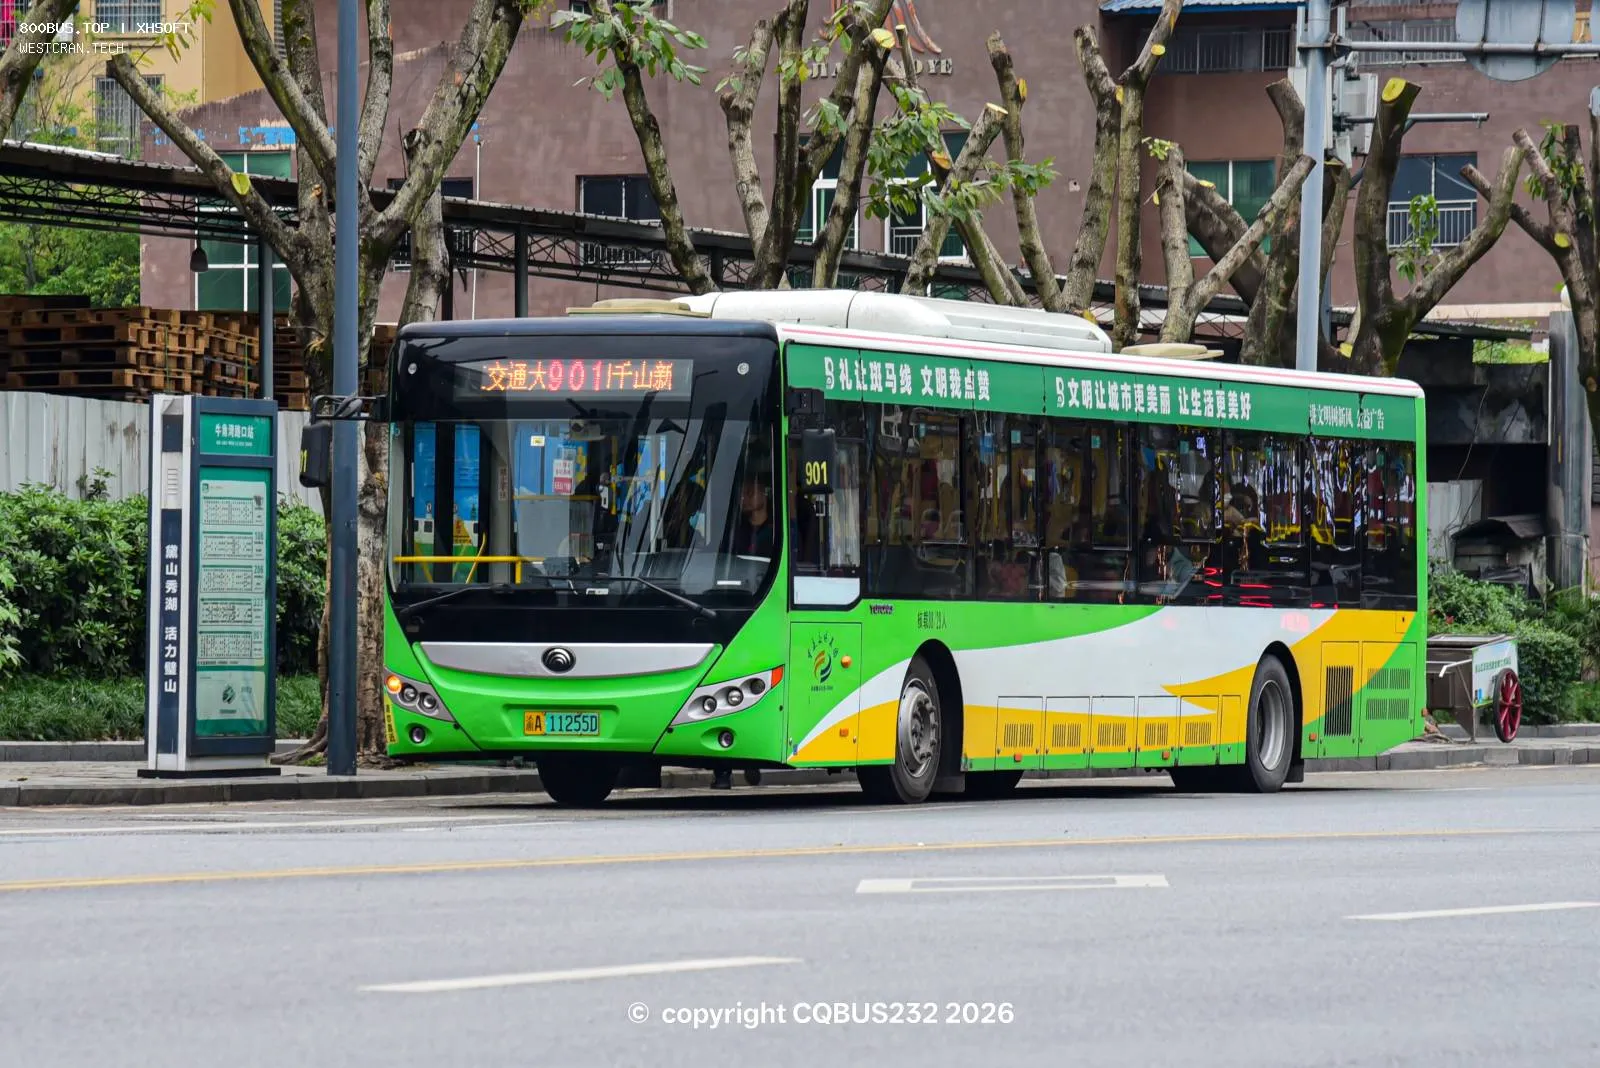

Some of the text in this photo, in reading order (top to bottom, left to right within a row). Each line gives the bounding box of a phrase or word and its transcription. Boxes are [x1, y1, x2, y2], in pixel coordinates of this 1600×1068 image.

[839, 358, 990, 401] 礼让斑马线 文明我点赞
[1067, 377, 1251, 421] 文明让城市更美丽 让生活更美好
[805, 461, 828, 485] 901
